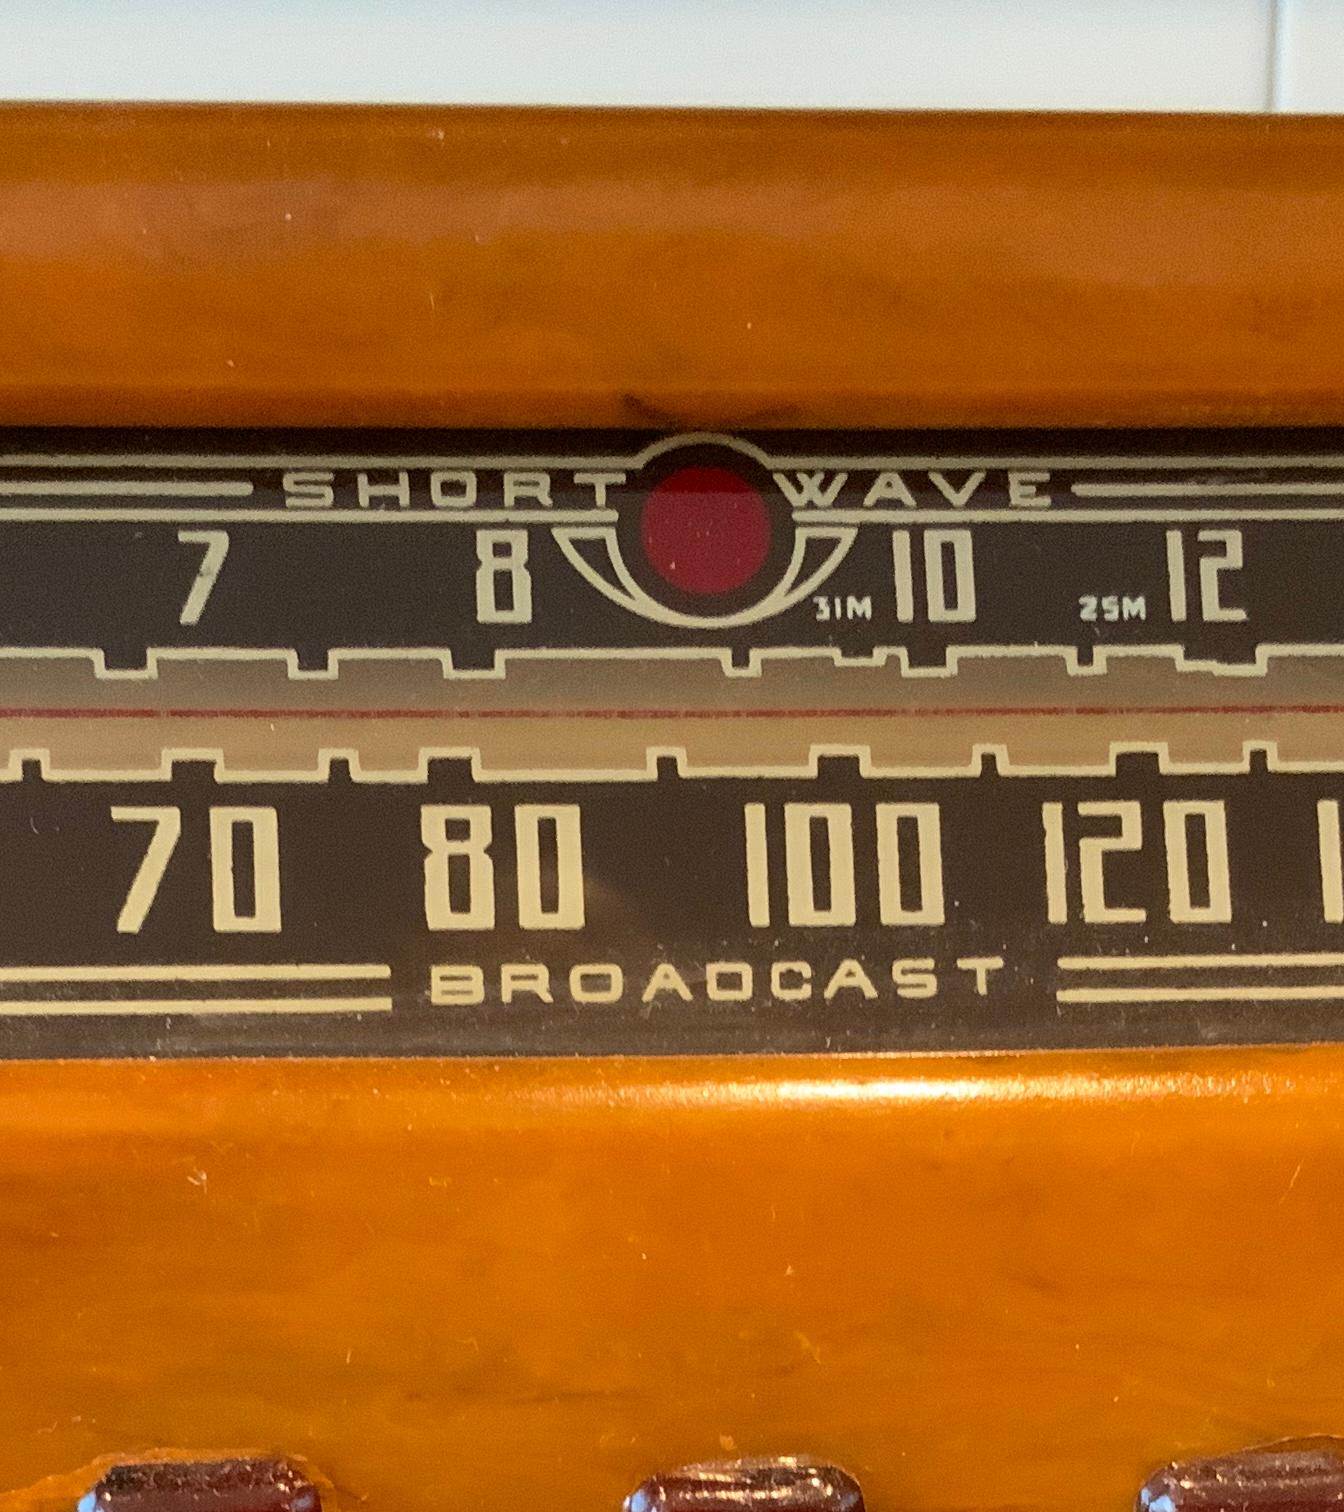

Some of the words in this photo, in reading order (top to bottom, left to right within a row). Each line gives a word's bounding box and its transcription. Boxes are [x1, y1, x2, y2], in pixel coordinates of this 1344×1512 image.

[282, 471, 626, 508] SHORT
[773, 471, 1052, 508] WAVE
[178, 530, 230, 625] 7
[475, 528, 533, 623] 8
[812, 596, 873, 621] 31M
[892, 529, 976, 622] 10
[1078, 596, 1146, 621] 25M
[1166, 529, 1248, 622] 12
[110, 806, 282, 934] 70
[420, 803, 586, 931] 80
[744, 801, 945, 928] 100
[1042, 799, 1232, 923] 120
[429, 956, 1004, 1006] BROADCAST
